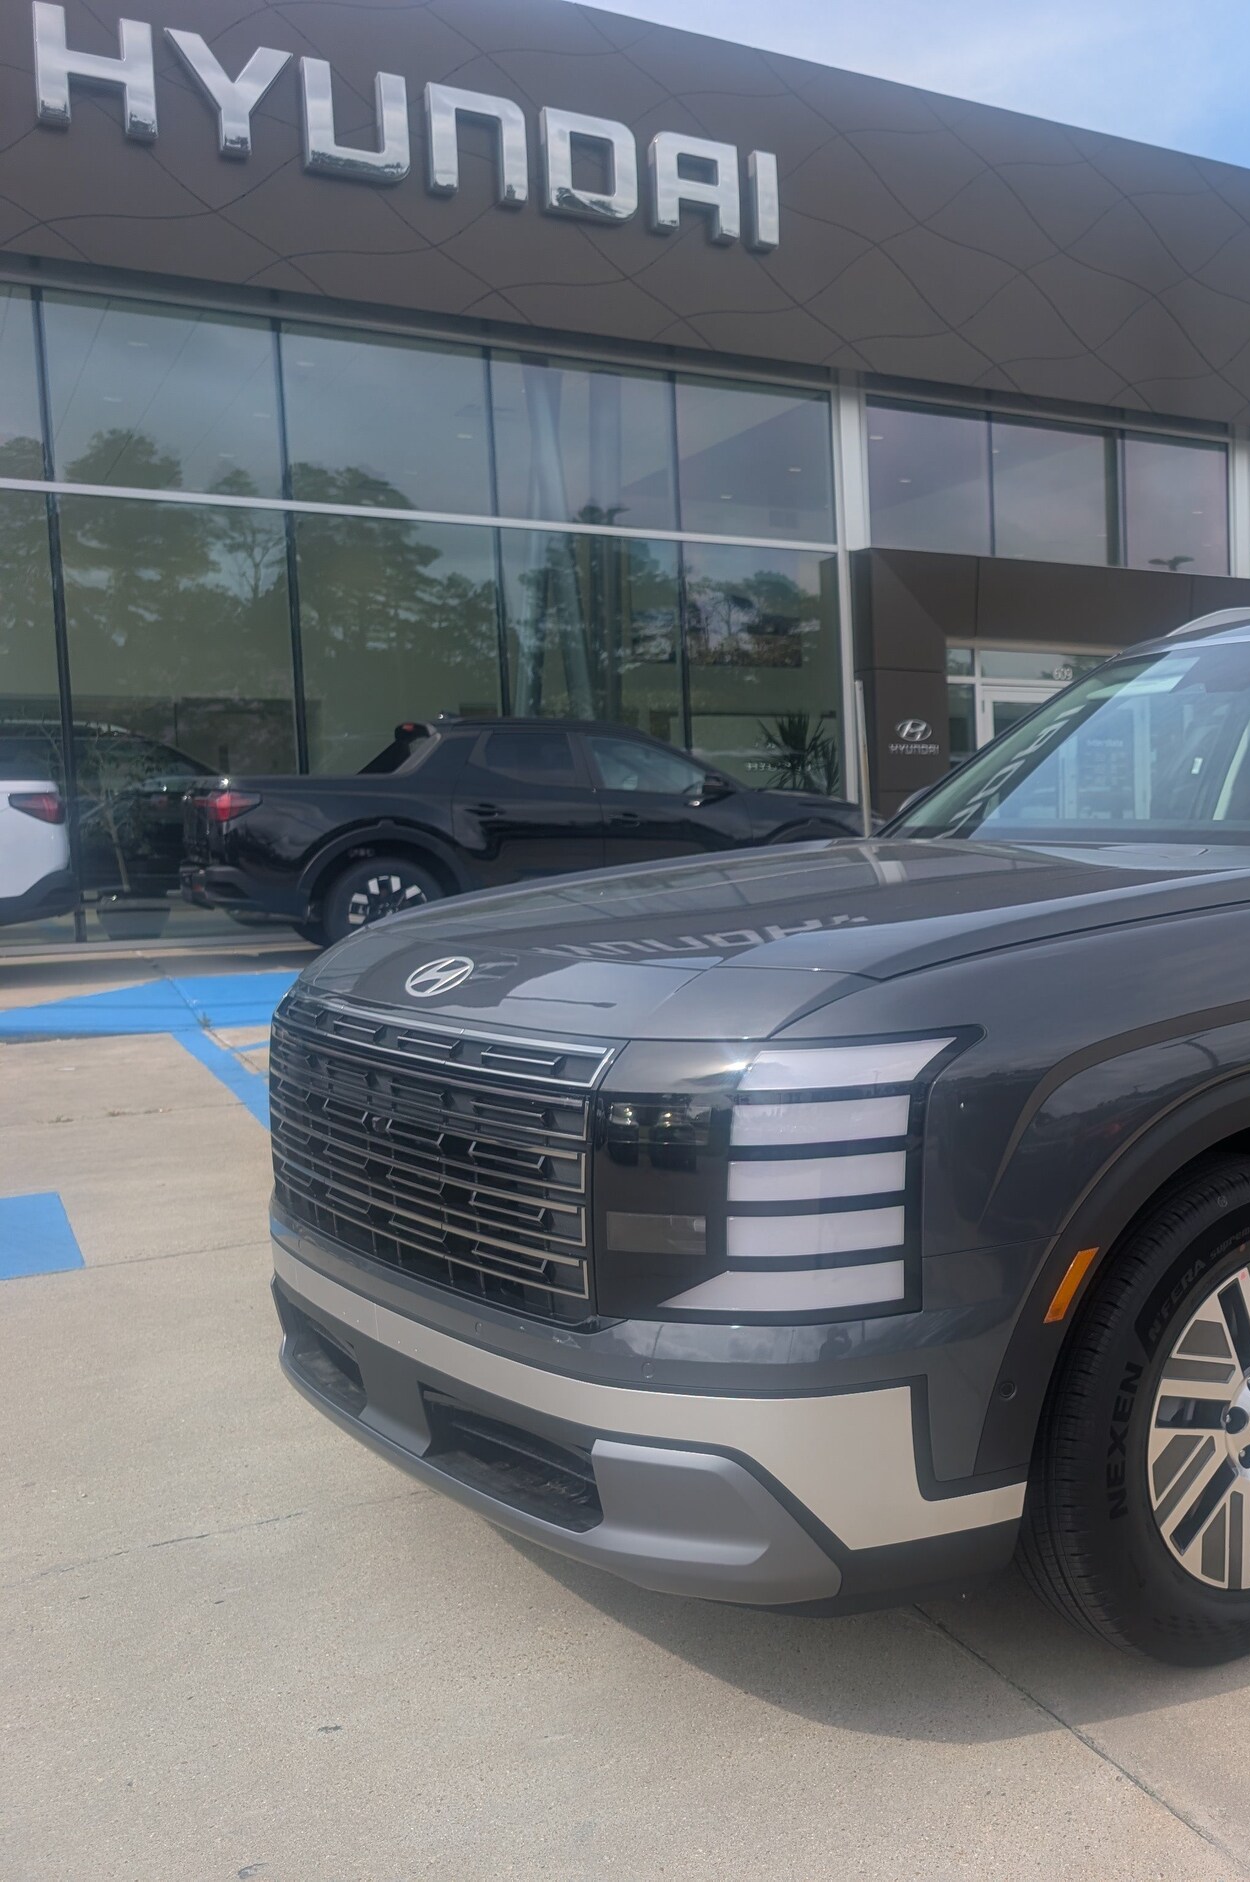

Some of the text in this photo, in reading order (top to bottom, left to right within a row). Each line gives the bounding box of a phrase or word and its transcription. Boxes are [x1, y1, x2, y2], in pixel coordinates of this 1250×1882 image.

[32, 1, 779, 251] HYUNDAI
[888, 743, 940, 755] HYUNDAI
[1105, 1360, 1145, 1520] NEXEN
